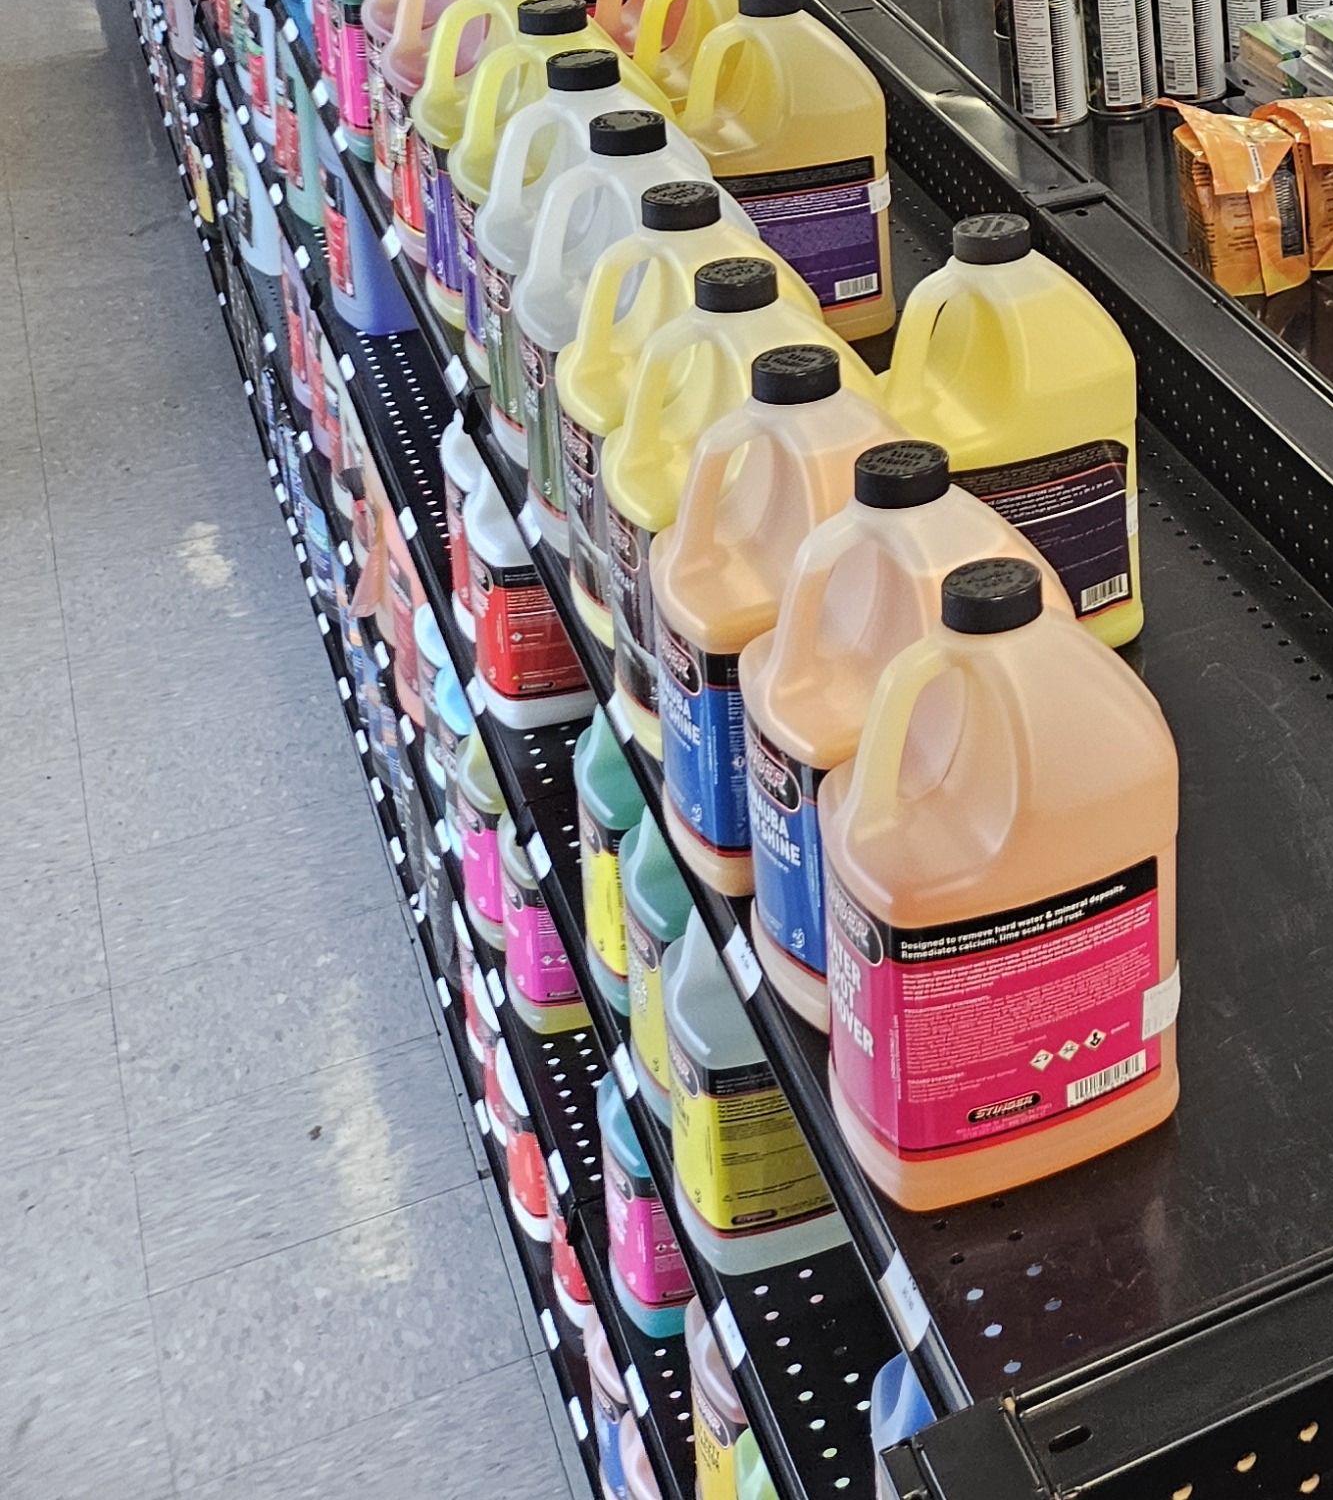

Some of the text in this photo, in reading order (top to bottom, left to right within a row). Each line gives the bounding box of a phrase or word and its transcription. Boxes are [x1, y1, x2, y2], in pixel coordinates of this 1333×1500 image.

[901, 883, 1127, 952] Designed to remove hard water & mineral deposits.
[901, 908, 1086, 961] Remediates calcium, lime scale and rust.
